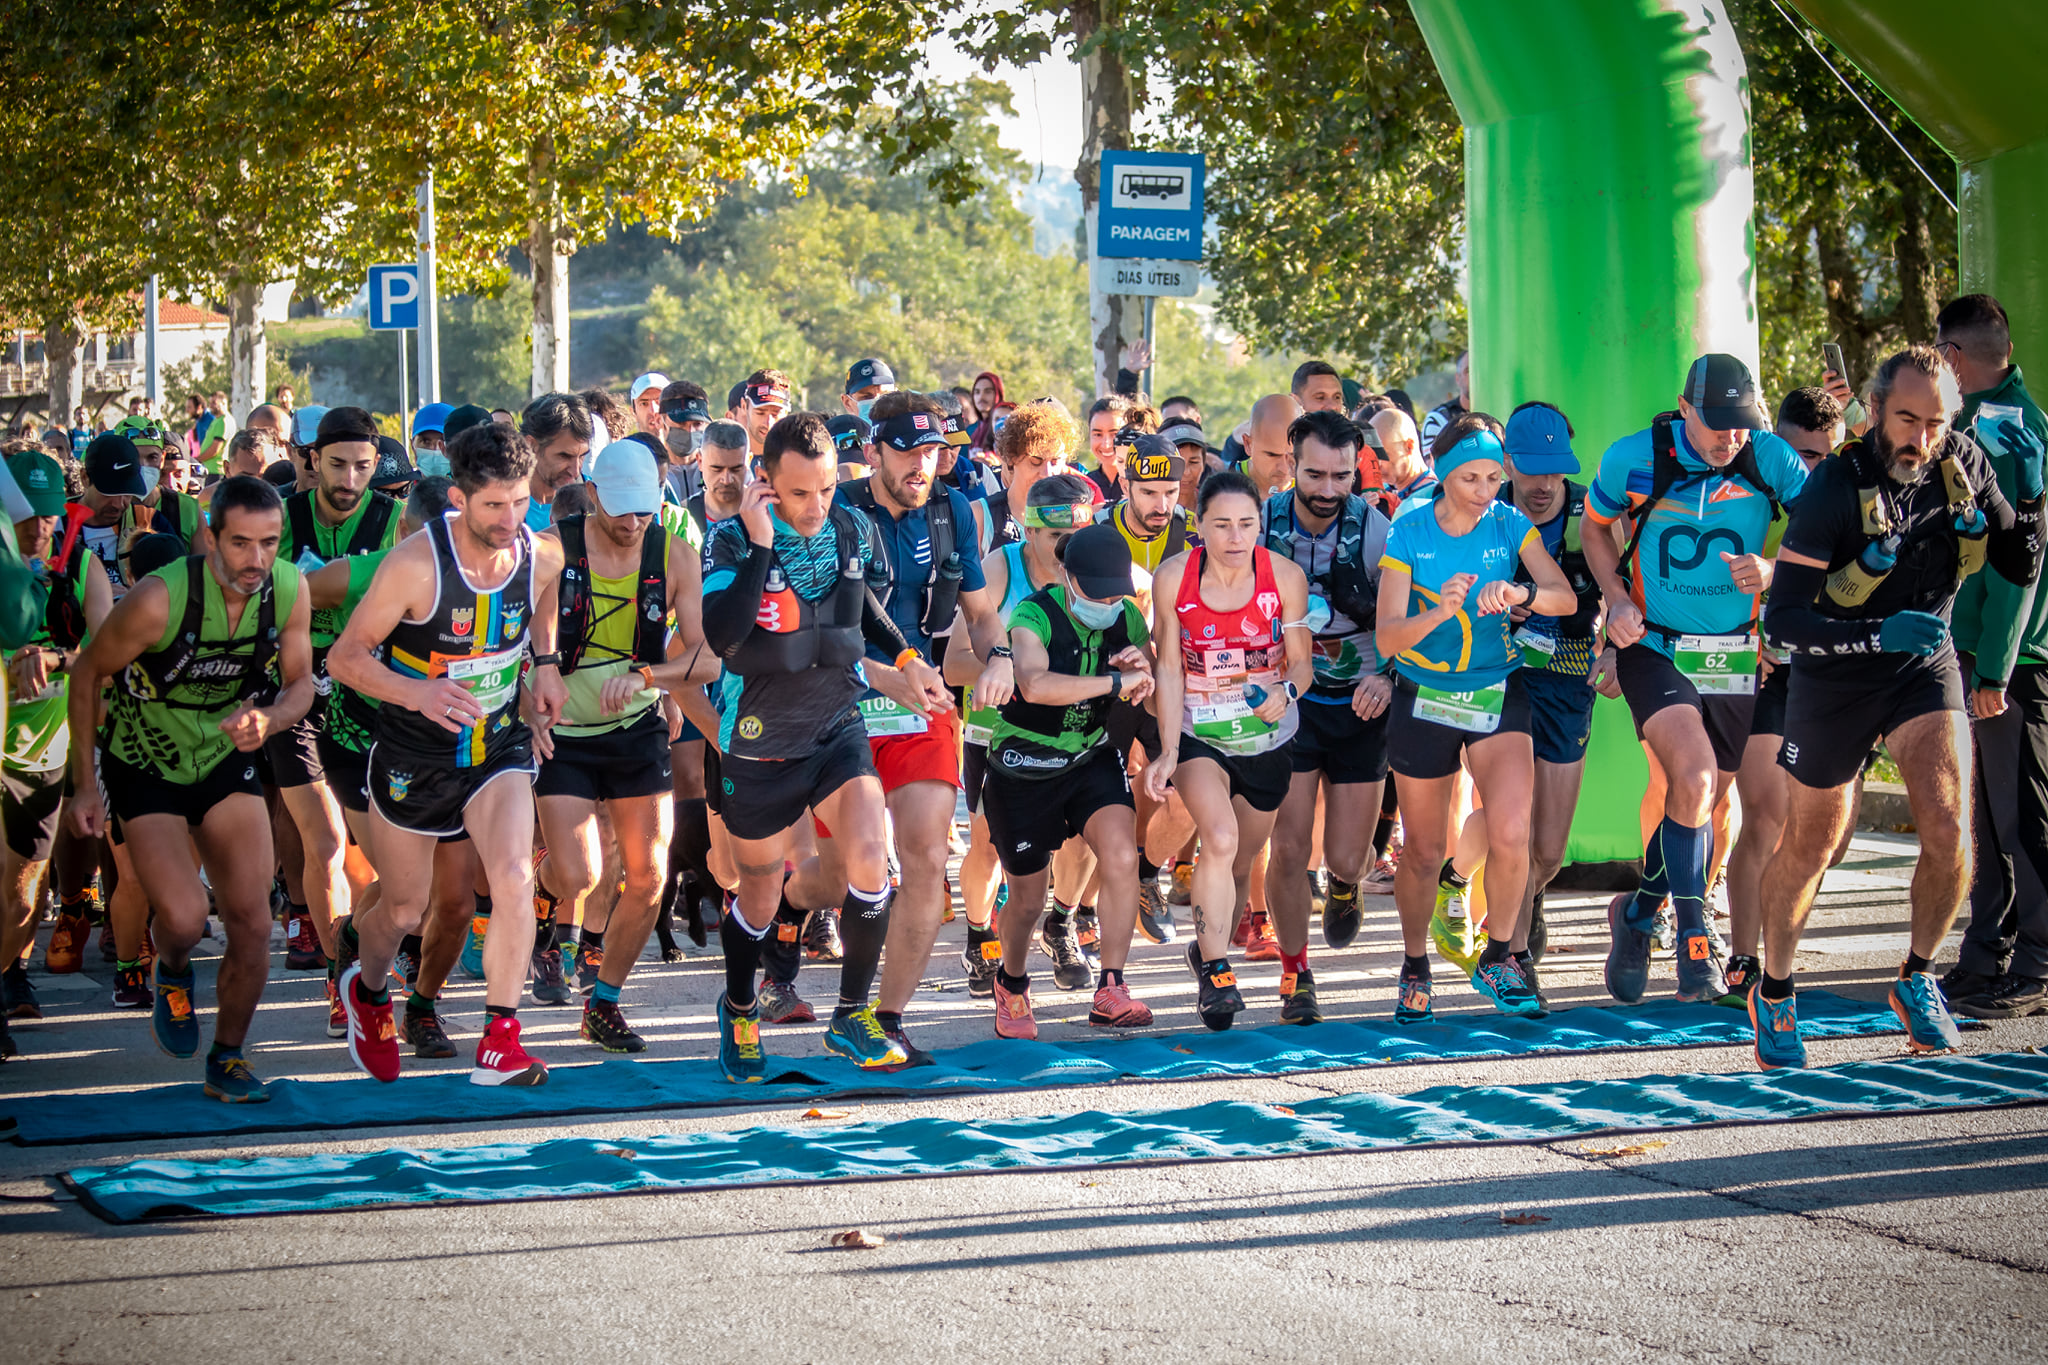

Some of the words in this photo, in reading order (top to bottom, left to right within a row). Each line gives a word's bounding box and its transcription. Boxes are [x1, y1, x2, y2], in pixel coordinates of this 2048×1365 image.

[1111, 225, 1190, 241] PARAGEM
[1117, 270, 1142, 284] DIAS
[381, 271, 419, 323] P
[1705, 653, 1728, 668] 62
[480, 671, 502, 689] 40
[863, 696, 897, 712] 106
[1231, 719, 1243, 735] 5
